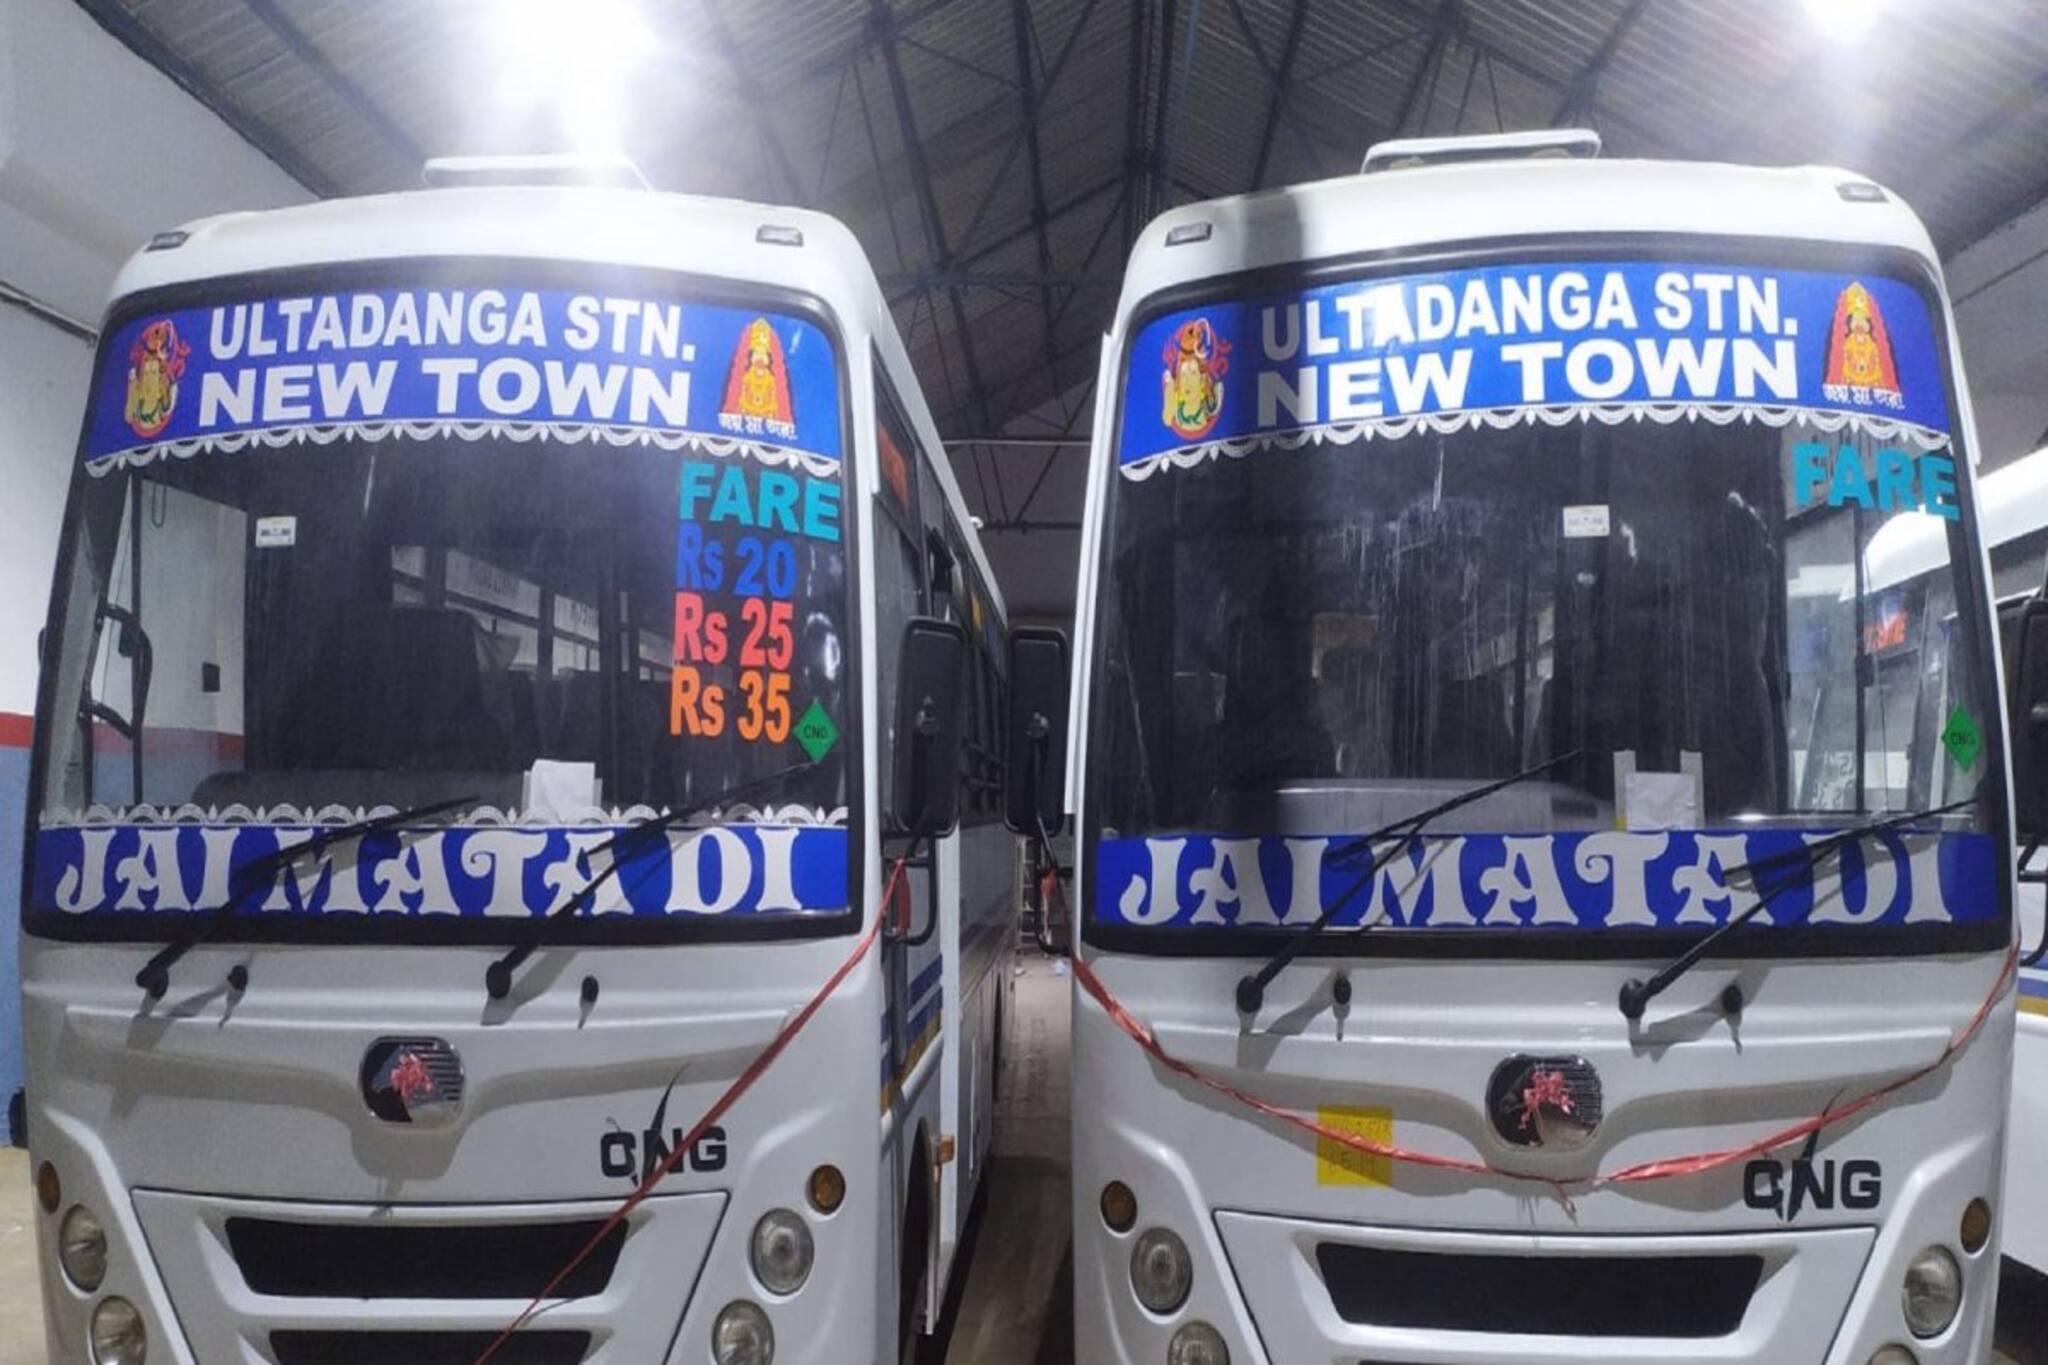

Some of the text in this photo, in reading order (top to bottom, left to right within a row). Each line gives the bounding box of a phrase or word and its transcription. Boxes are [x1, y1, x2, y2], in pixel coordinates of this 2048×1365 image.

[210, 289, 697, 362] ULTADANGA STN.
[1262, 271, 1798, 362] ULTADANGA STN.
[199, 358, 690, 427] NEW TOWN
[1257, 337, 1798, 428] NEW TOWN
[678, 458, 841, 542] FARE
[1791, 440, 1961, 523] FARE
[674, 519, 796, 599] Rs 20
[673, 591, 794, 671] Rs 25
[670, 664, 791, 744] Rs 35
[55, 826, 801, 917] JAI MATA DI
[1119, 832, 1953, 927] JAI MATA DI
[601, 1125, 728, 1180] CNG
[1743, 1158, 1882, 1213] CNG
